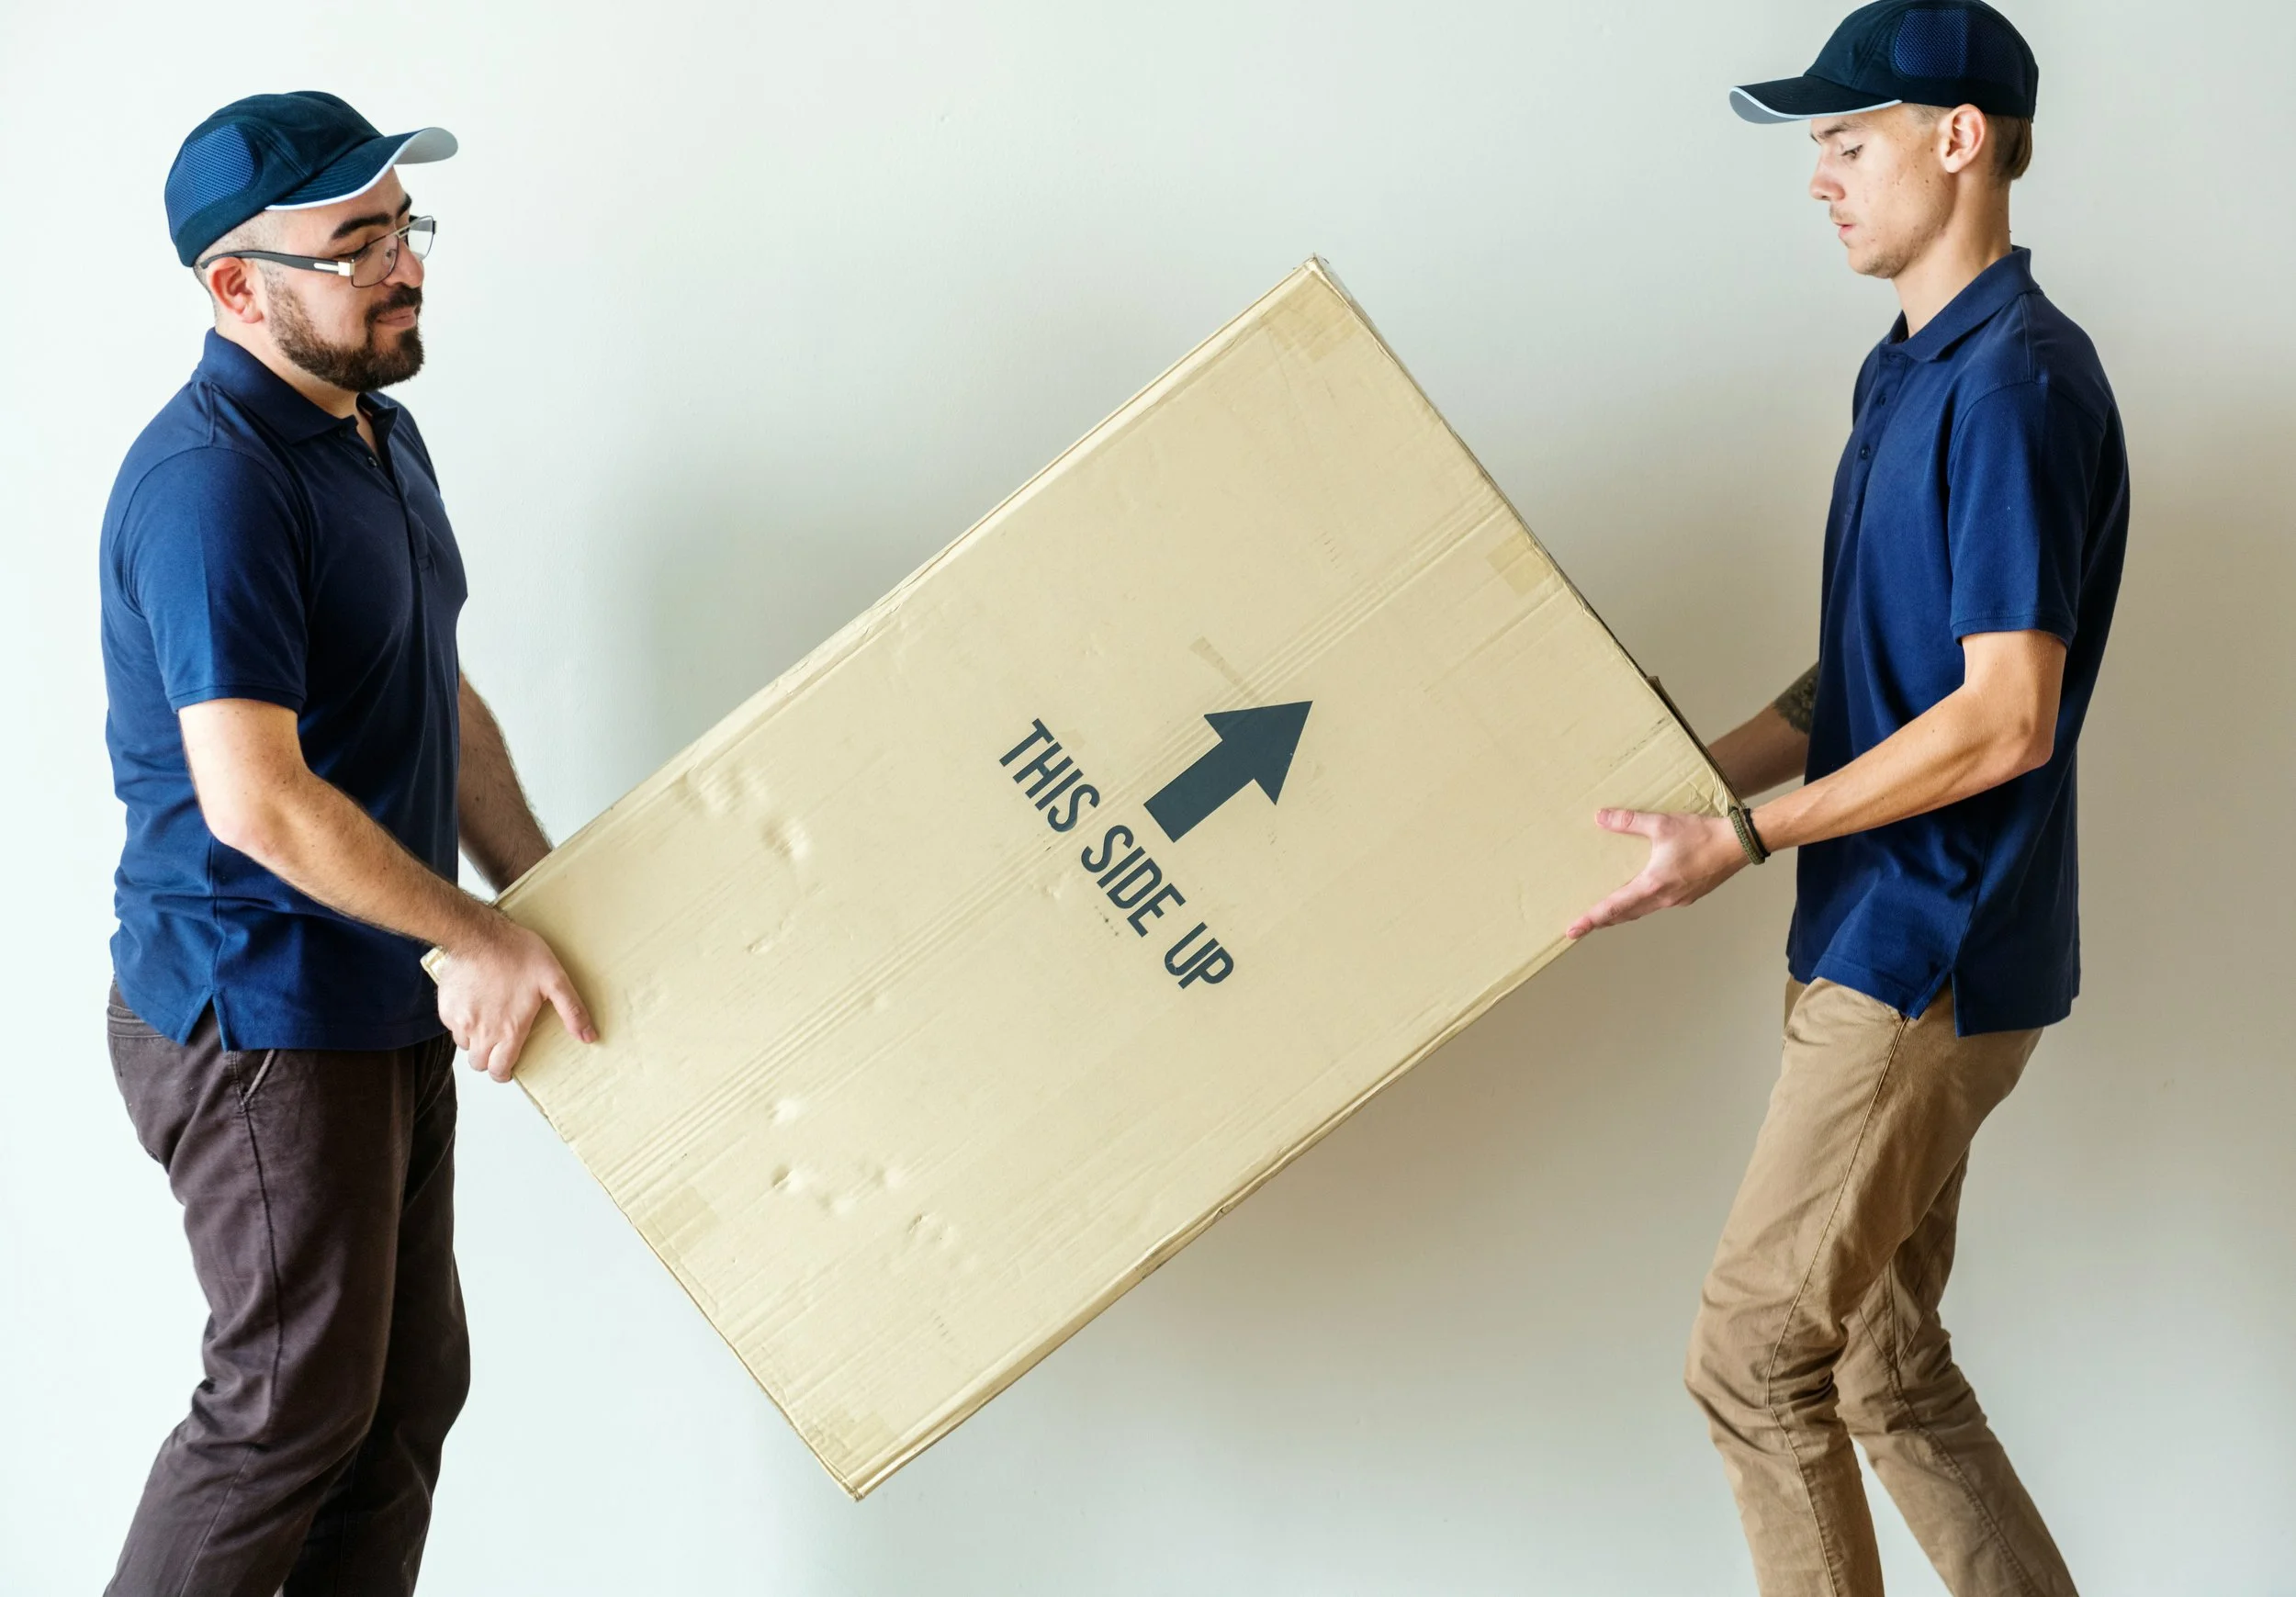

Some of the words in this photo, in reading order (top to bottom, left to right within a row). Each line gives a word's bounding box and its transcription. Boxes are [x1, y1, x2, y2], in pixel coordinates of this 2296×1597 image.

[998, 717, 1100, 833] THIS
[1080, 825, 1187, 938] SIDE
[1164, 921, 1234, 990] UP
